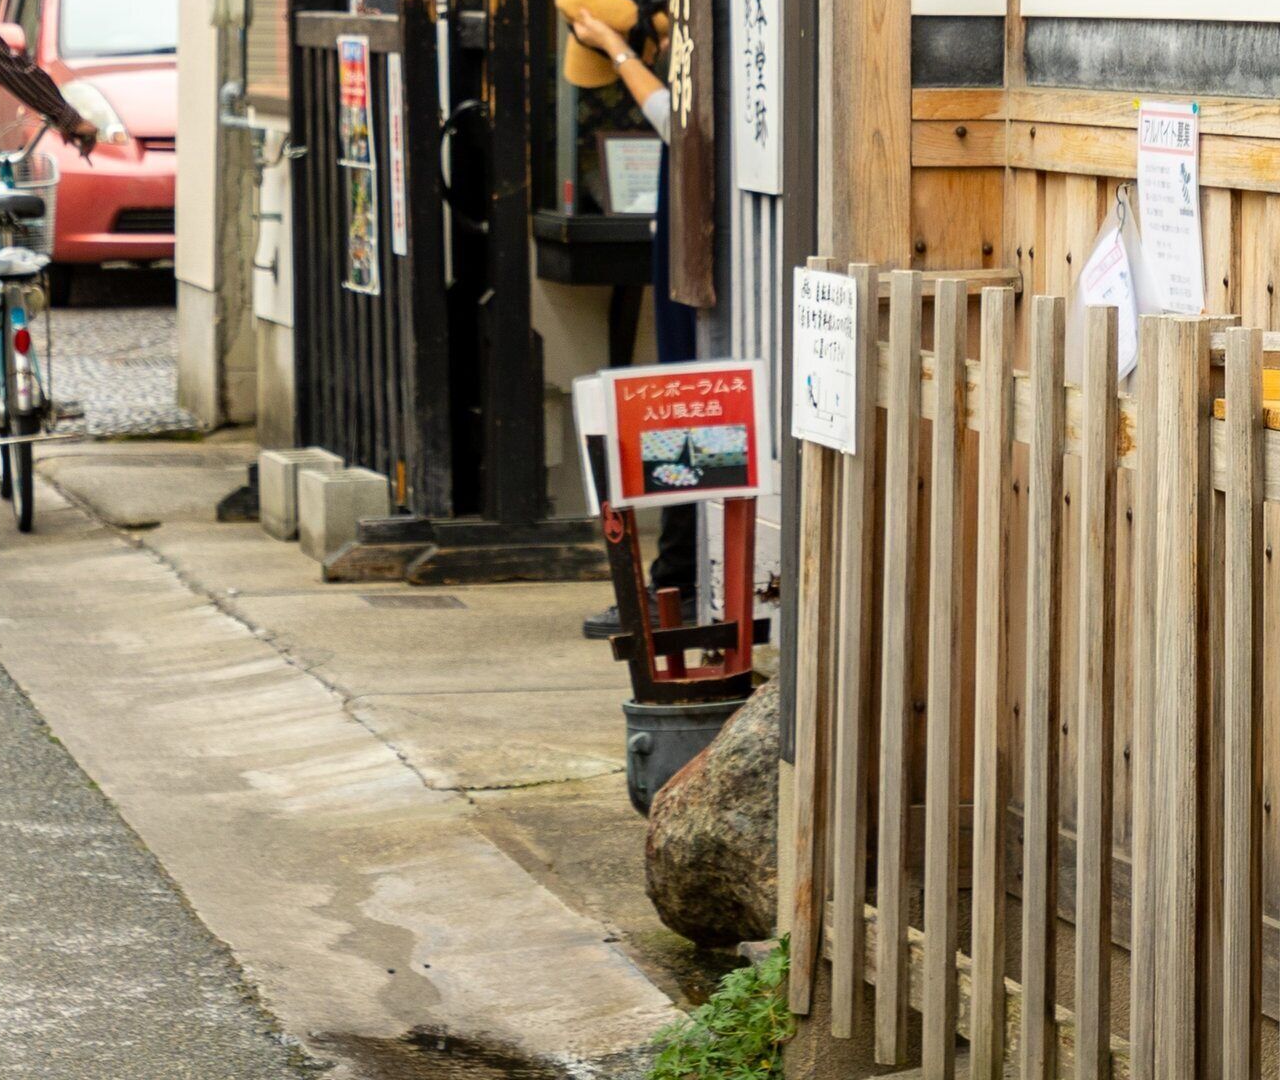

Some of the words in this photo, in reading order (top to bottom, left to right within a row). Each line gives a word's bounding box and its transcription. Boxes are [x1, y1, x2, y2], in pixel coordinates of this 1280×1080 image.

[622, 376, 748, 402] レインボーラムネ
[642, 400, 723, 422] 入り限定品
